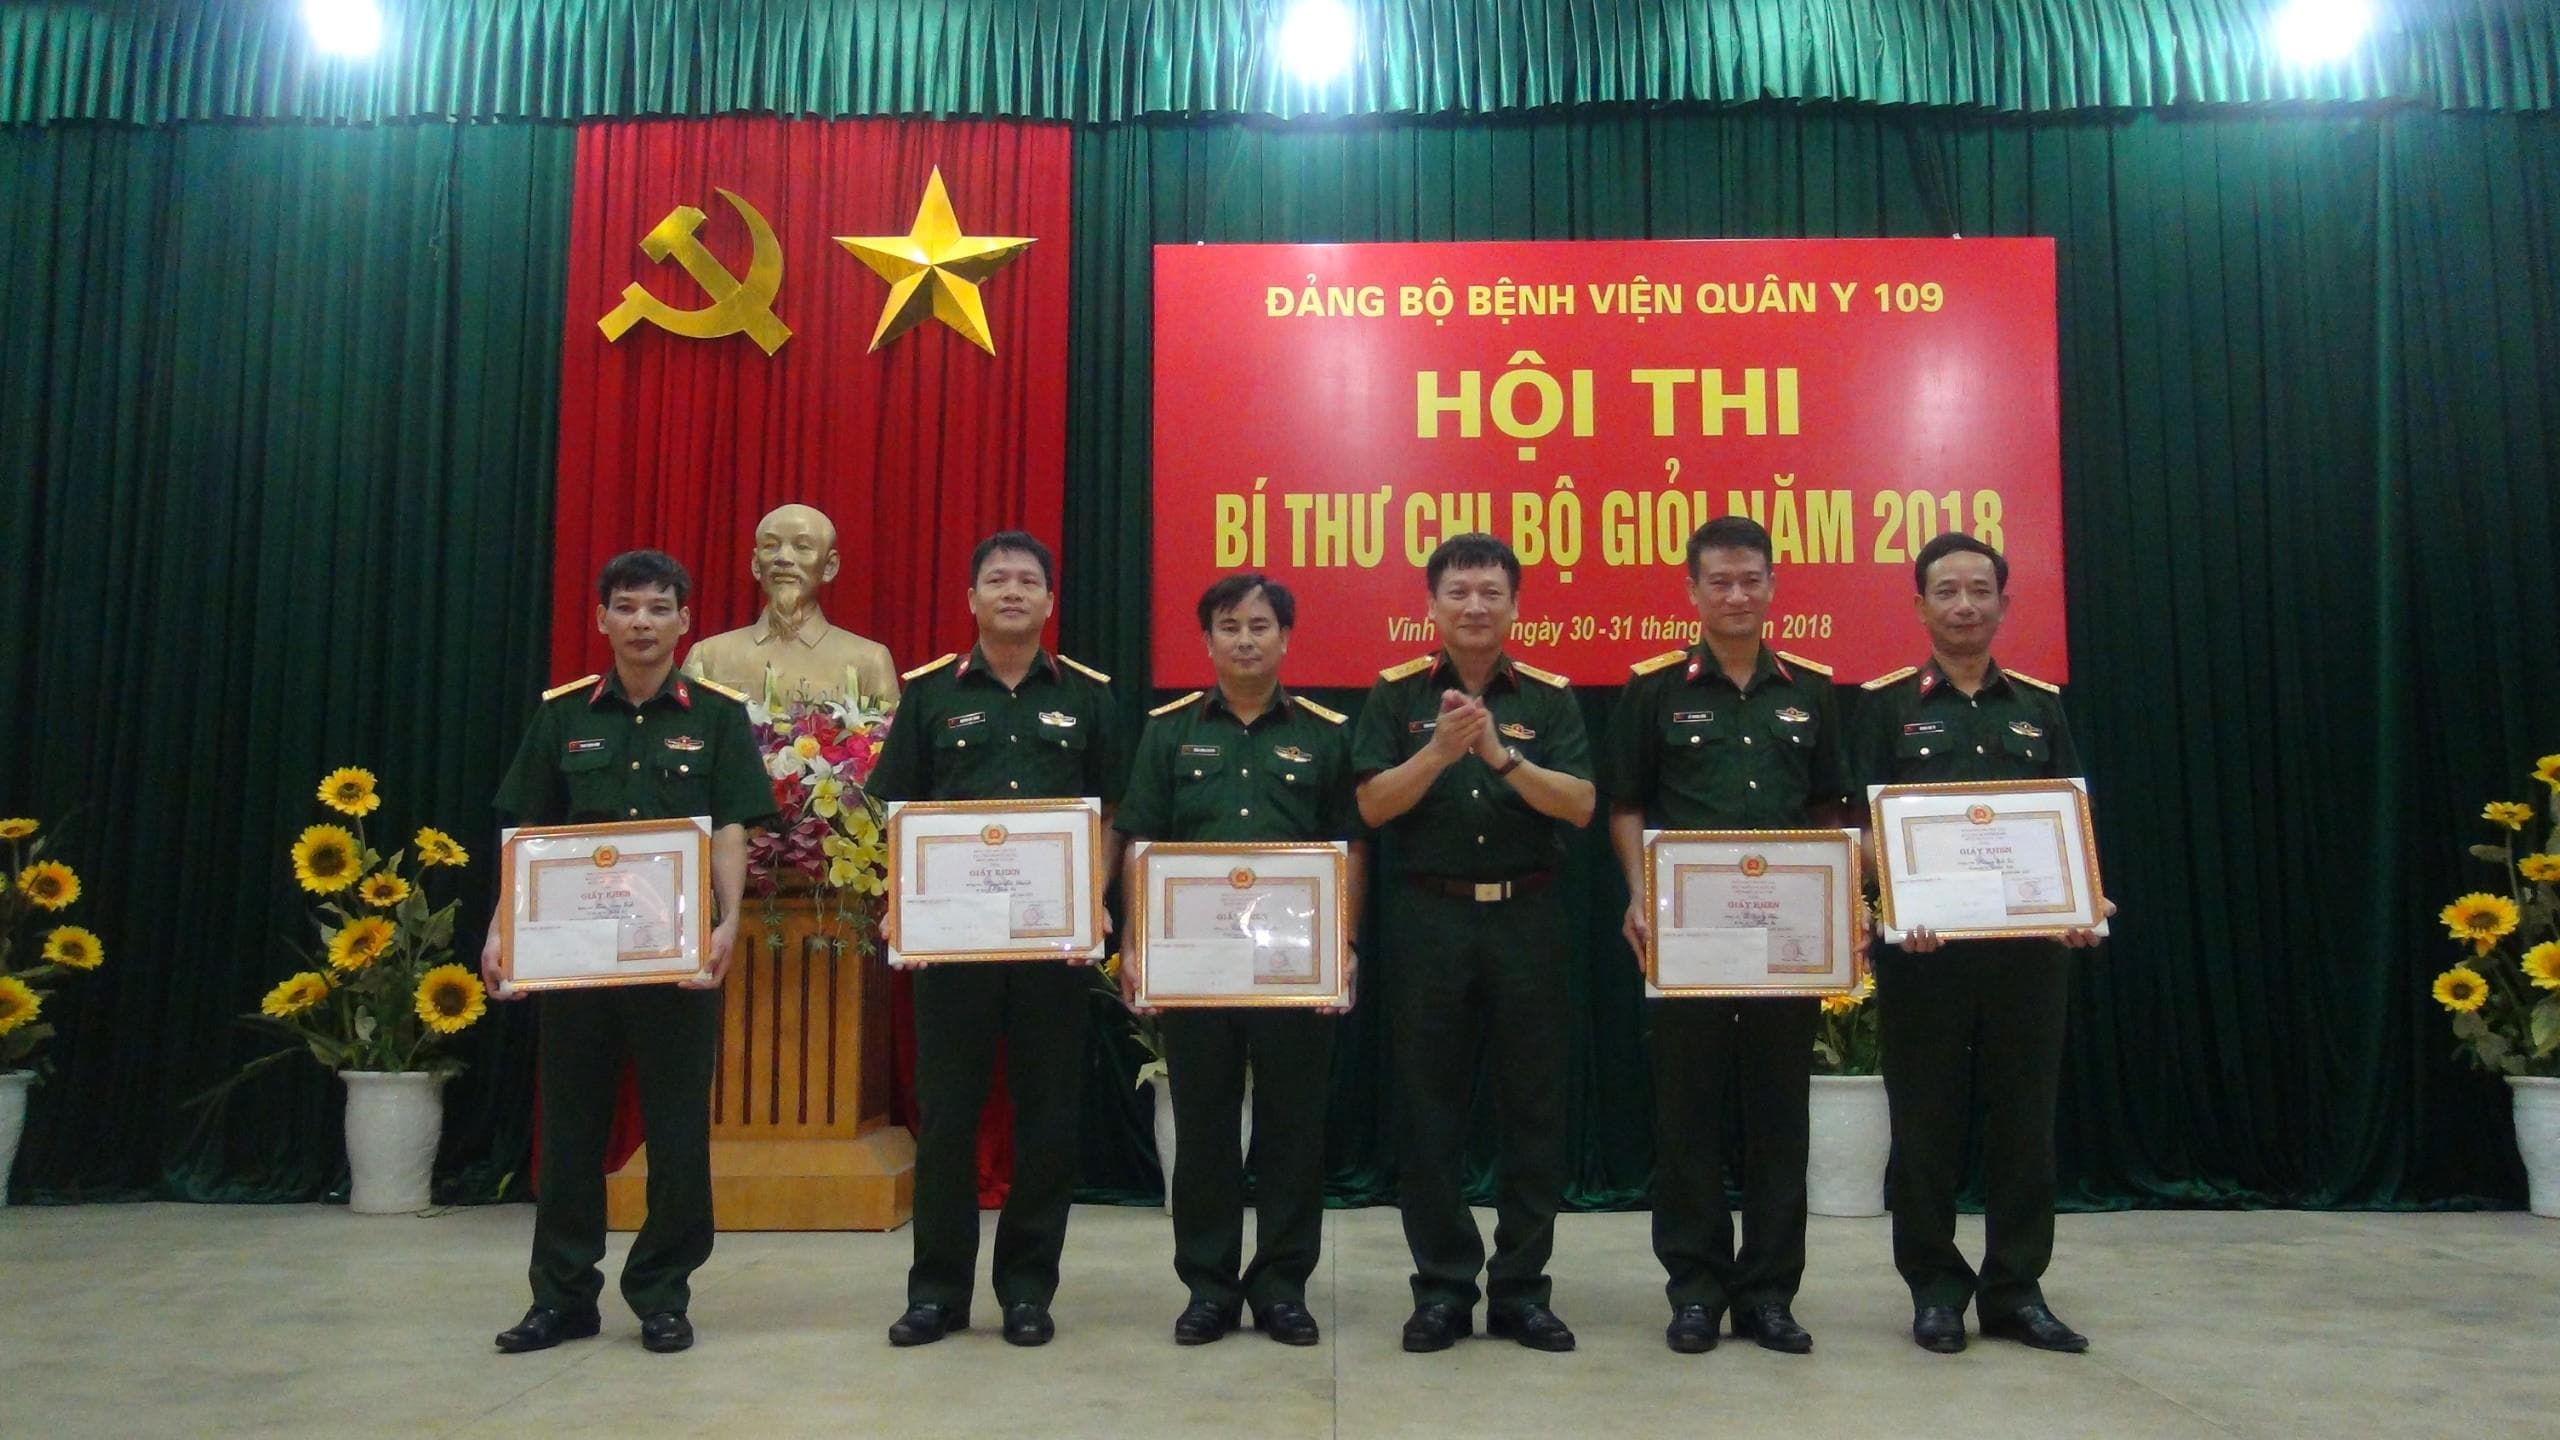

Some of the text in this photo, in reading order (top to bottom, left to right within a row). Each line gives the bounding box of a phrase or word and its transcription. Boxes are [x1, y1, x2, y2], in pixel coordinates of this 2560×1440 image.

[1264, 272, 1945, 327] ĐẢNG BỘ BỆNH VIỆN QUÂN Y 109
[1416, 350, 1801, 462] HỘI THI
[1215, 476, 1267, 568] BÍ
[1284, 484, 1393, 568] THƯ
[1511, 475, 1583, 584] BỘ
[1872, 487, 2006, 565] 2018
[1387, 615, 1435, 642] Vĩnh
[1510, 614, 1564, 647] ngày
[1641, 614, 1702, 646] tháng
[1781, 613, 1833, 640] 2018
